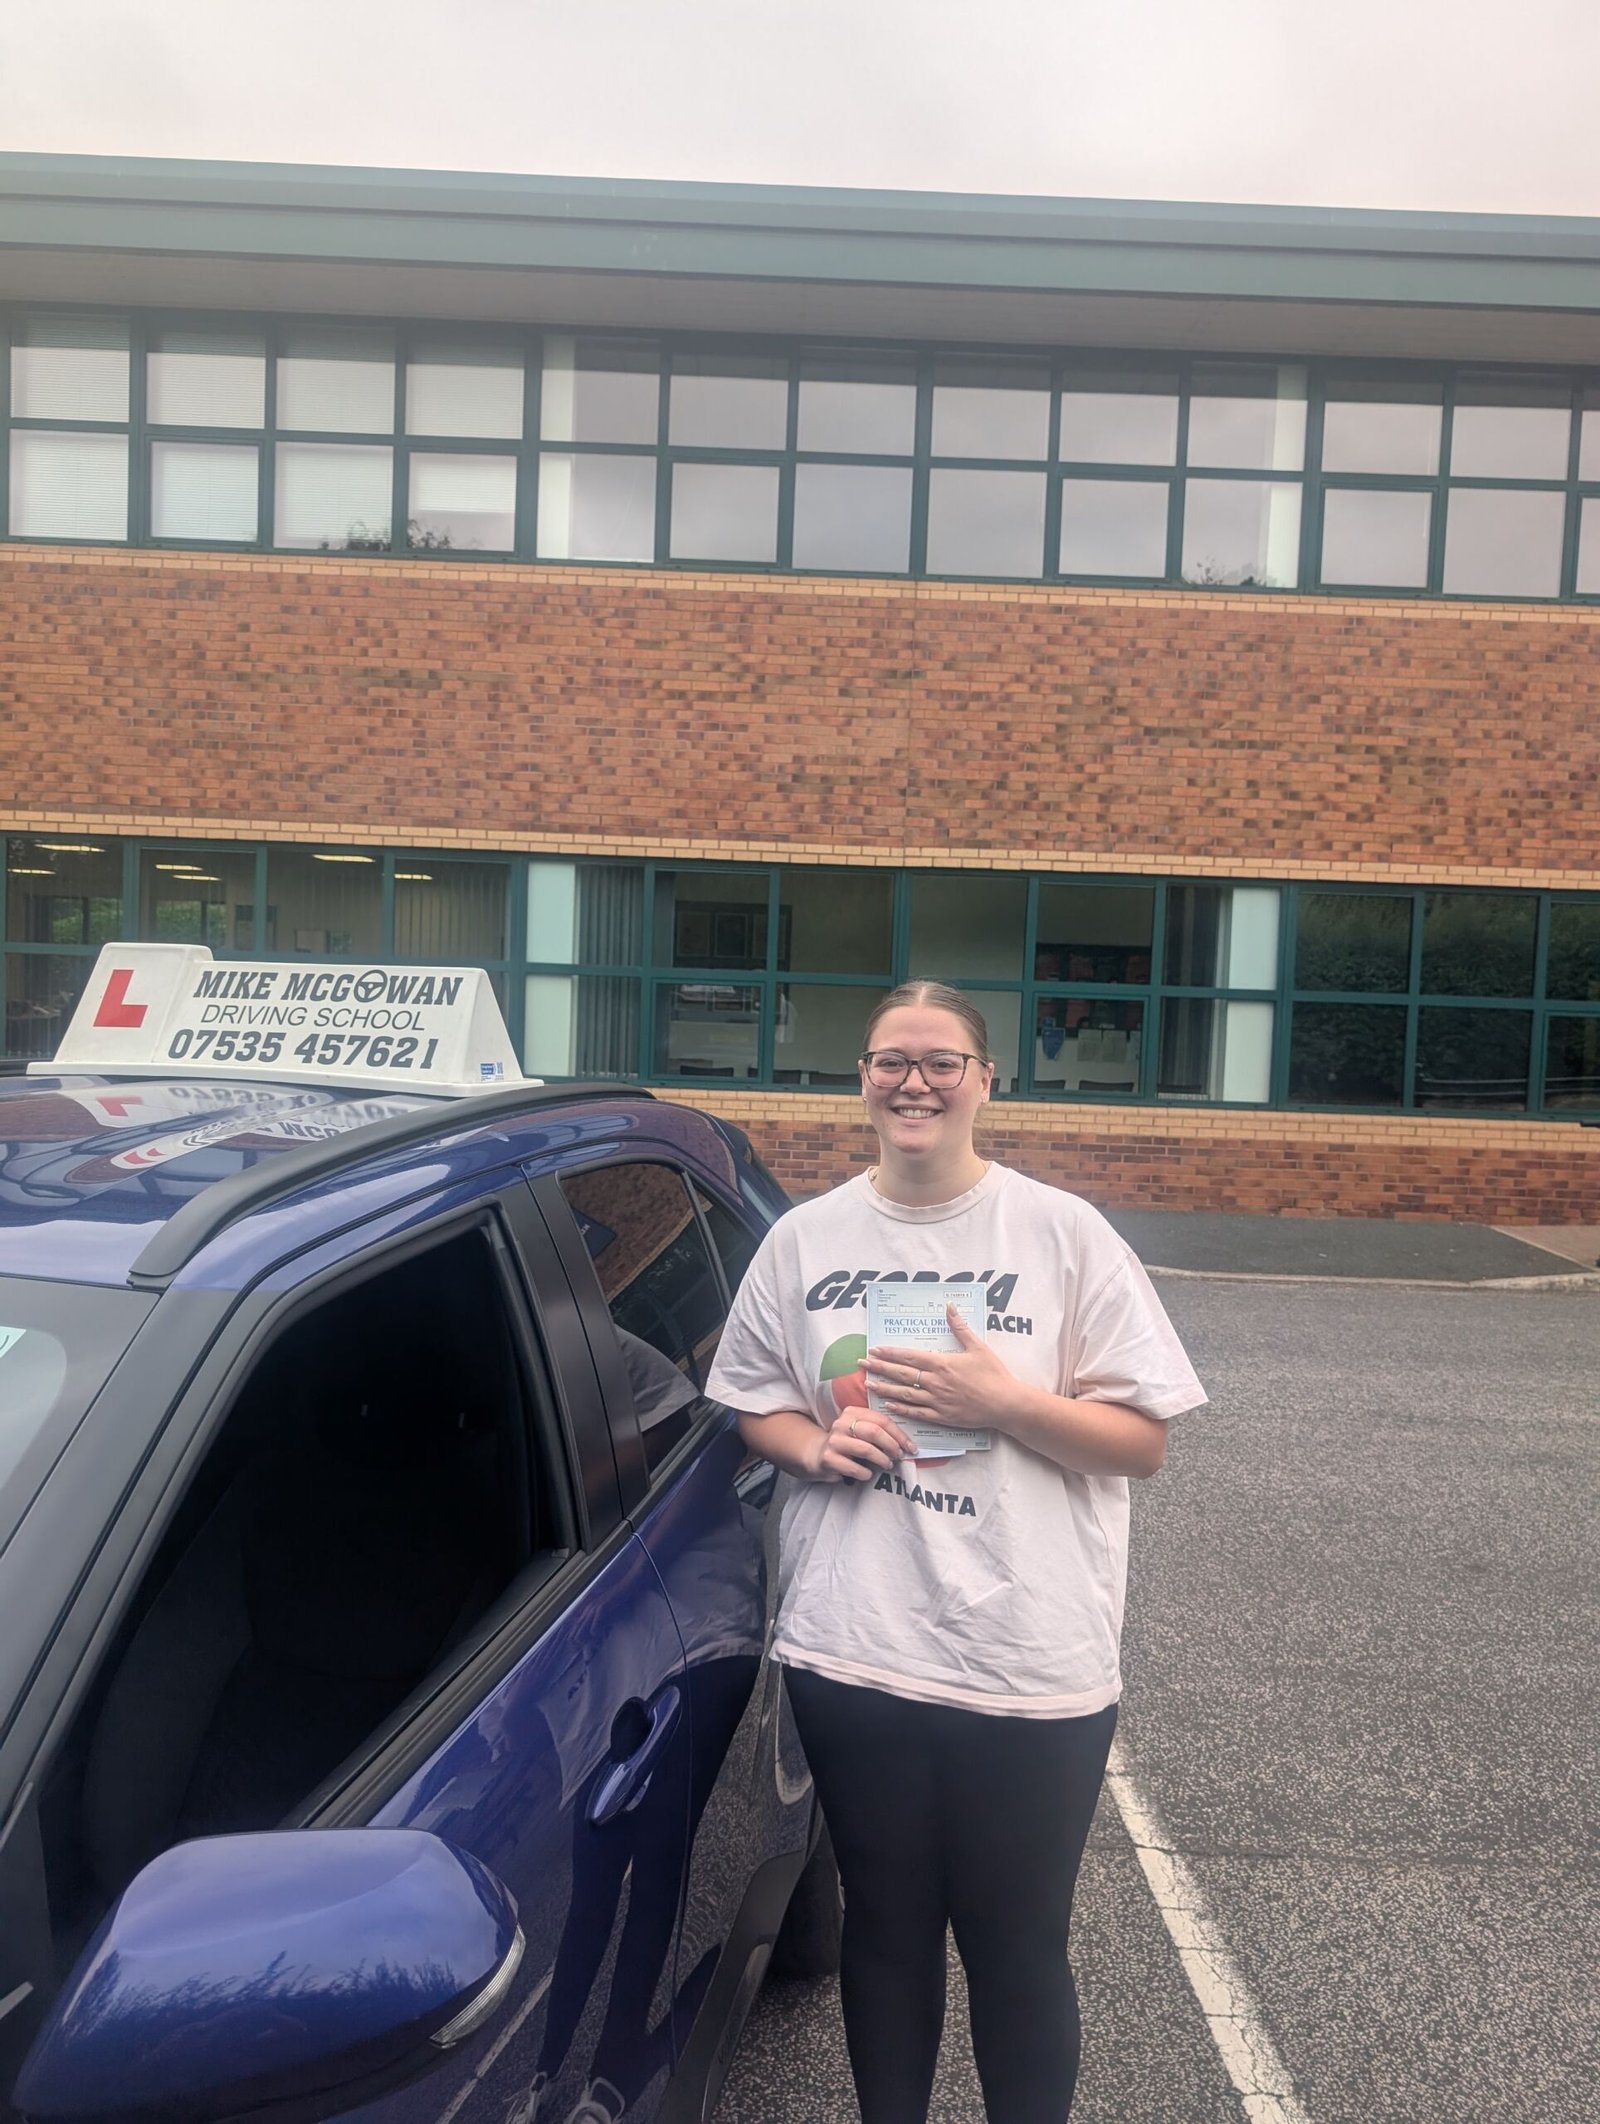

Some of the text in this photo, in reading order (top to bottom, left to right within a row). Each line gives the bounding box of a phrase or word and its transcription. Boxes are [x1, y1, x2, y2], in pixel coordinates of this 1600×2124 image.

[93, 969, 148, 1028] L
[193, 969, 464, 1006] MIKE MCGOWAN
[200, 1004, 425, 1031] DRIVING SCHOOL
[167, 1028, 439, 1069] 07535 457621
[884, 1318, 928, 1326] PRACTICAL
[986, 1313, 1032, 1336] ACH
[874, 1472, 976, 1517] ATLANTA
